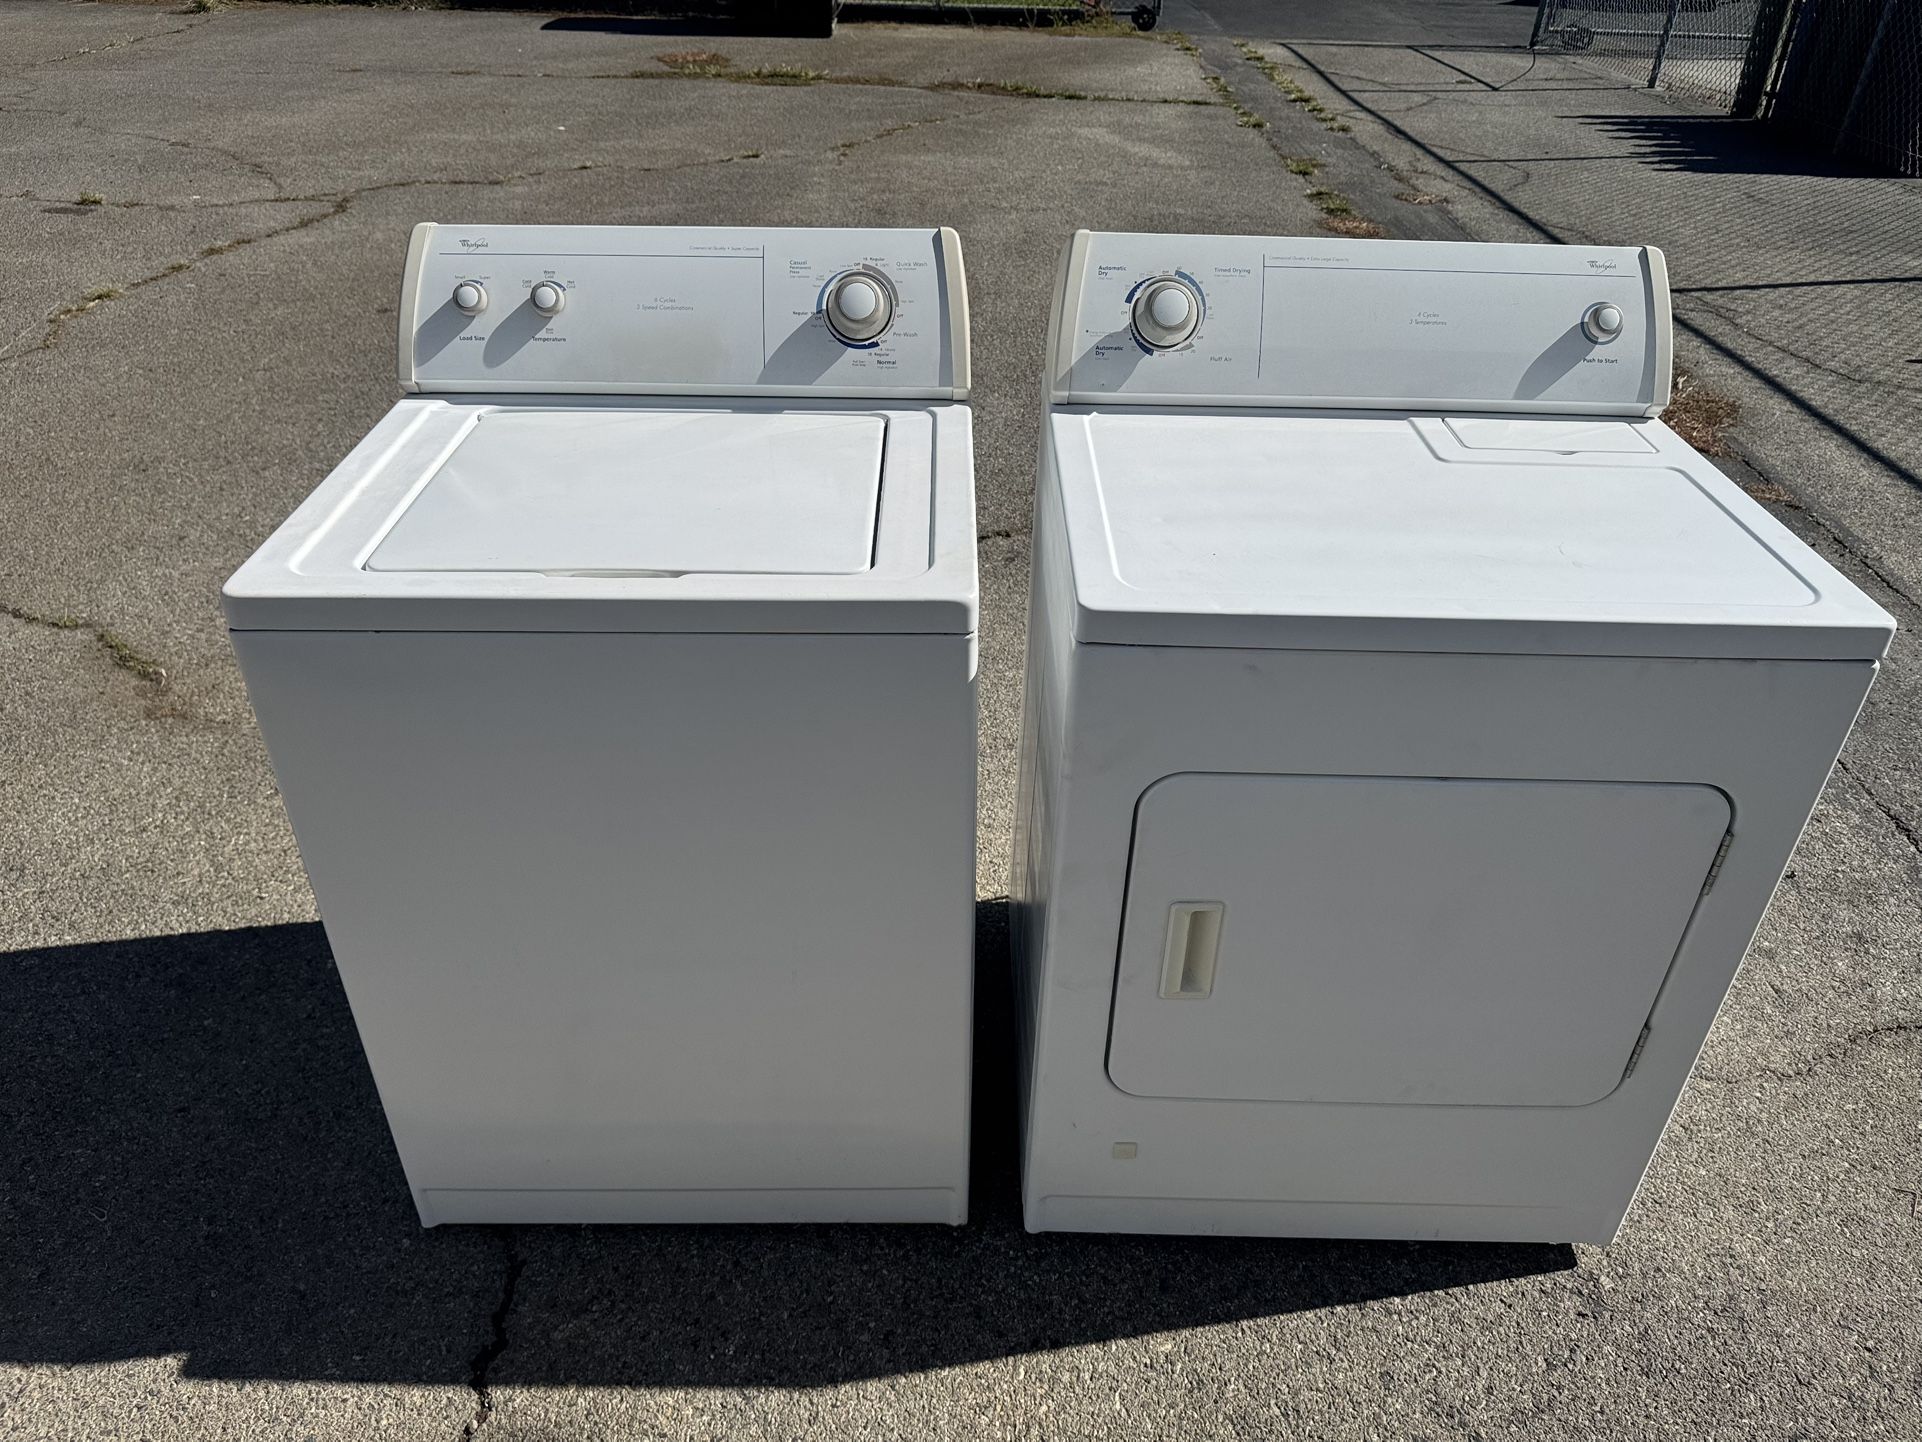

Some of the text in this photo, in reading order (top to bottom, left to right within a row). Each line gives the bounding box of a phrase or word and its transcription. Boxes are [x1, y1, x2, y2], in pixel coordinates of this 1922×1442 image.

[459, 239, 489, 251] Whirlpool
[1587, 260, 1617, 272] Whirlpool
[1423, 311, 1440, 319] Cycles
